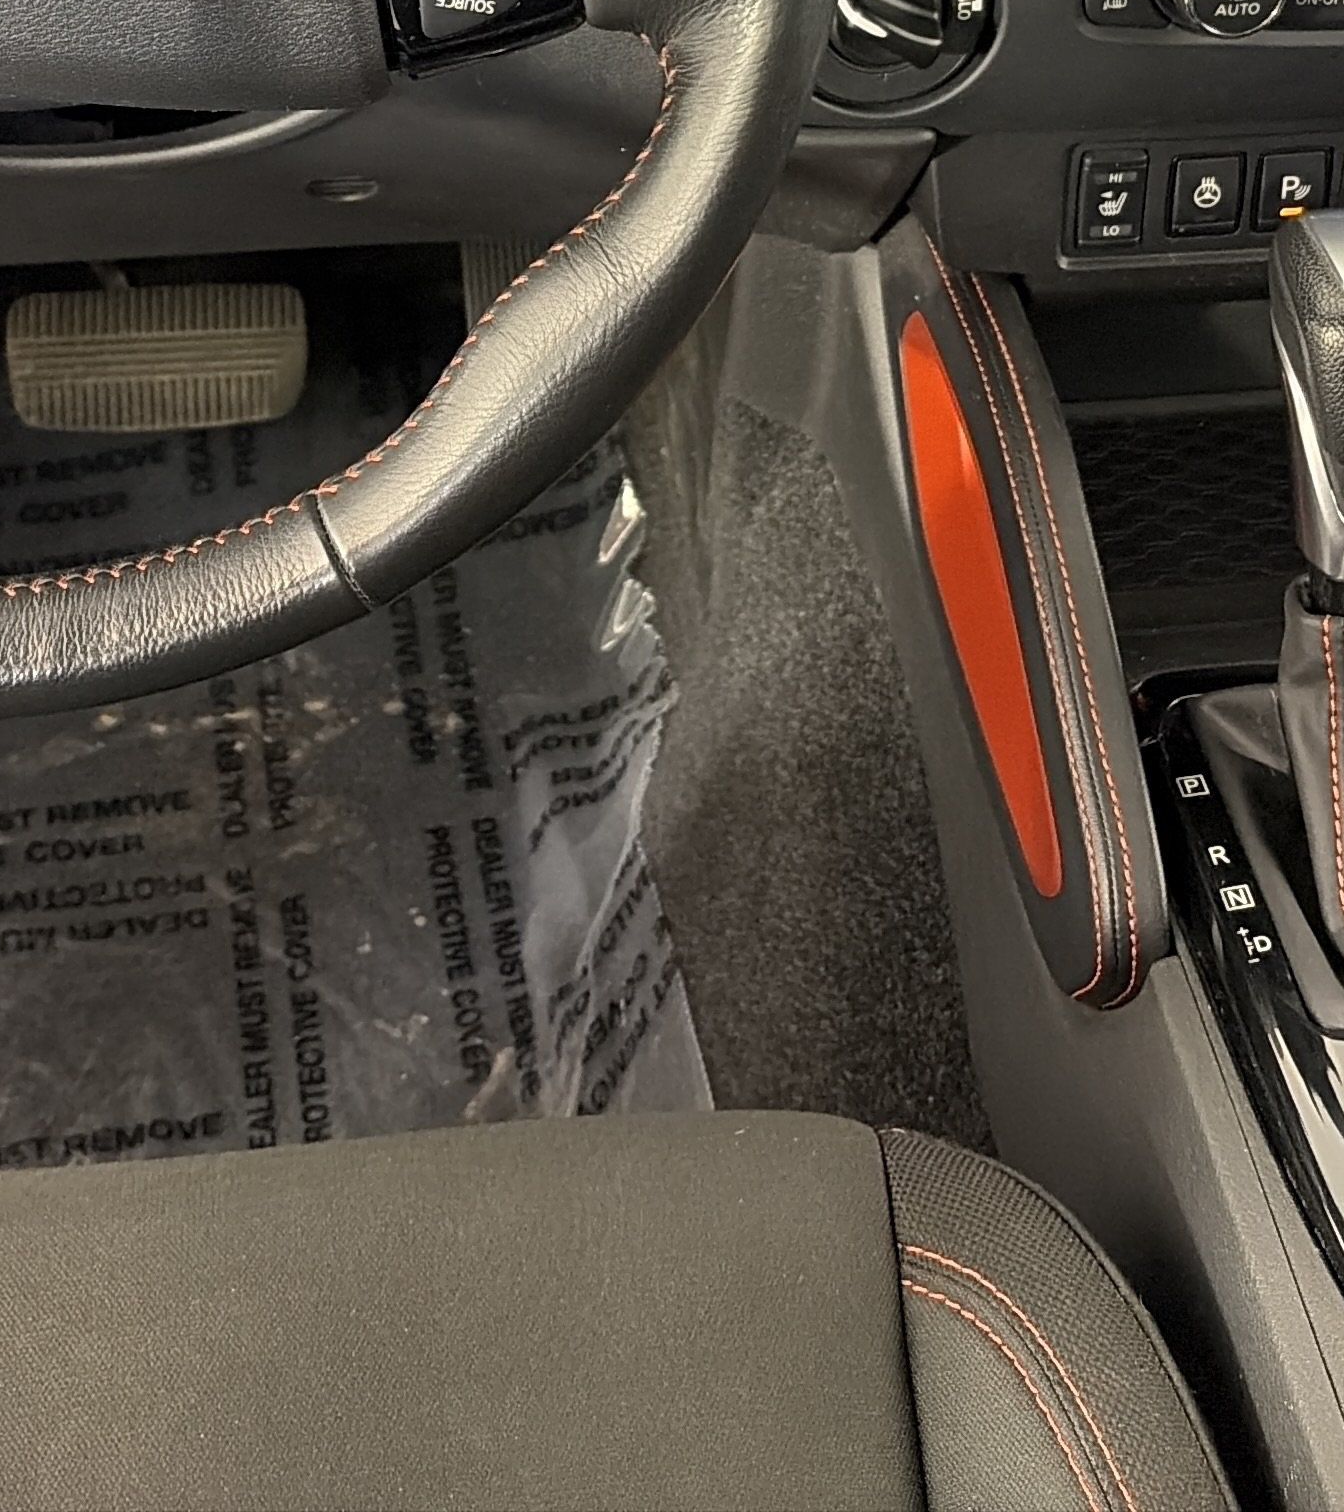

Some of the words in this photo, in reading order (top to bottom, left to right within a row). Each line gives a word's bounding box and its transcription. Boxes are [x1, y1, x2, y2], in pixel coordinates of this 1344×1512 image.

[1214, 3, 1261, 17] AUTO
[1108, 173, 1123, 184] HI
[1103, 225, 1120, 236] LO
[46, 789, 193, 825] REMOVE
[24, 833, 146, 864] COVER
[1208, 845, 1230, 865] R
[1254, 935, 1272, 953] D
[237, 978, 270, 1052] MUST
[289, 988, 334, 1144] ROTECTIVE
[242, 1058, 277, 1150] EALER
[61, 1110, 226, 1157] REMOVE
